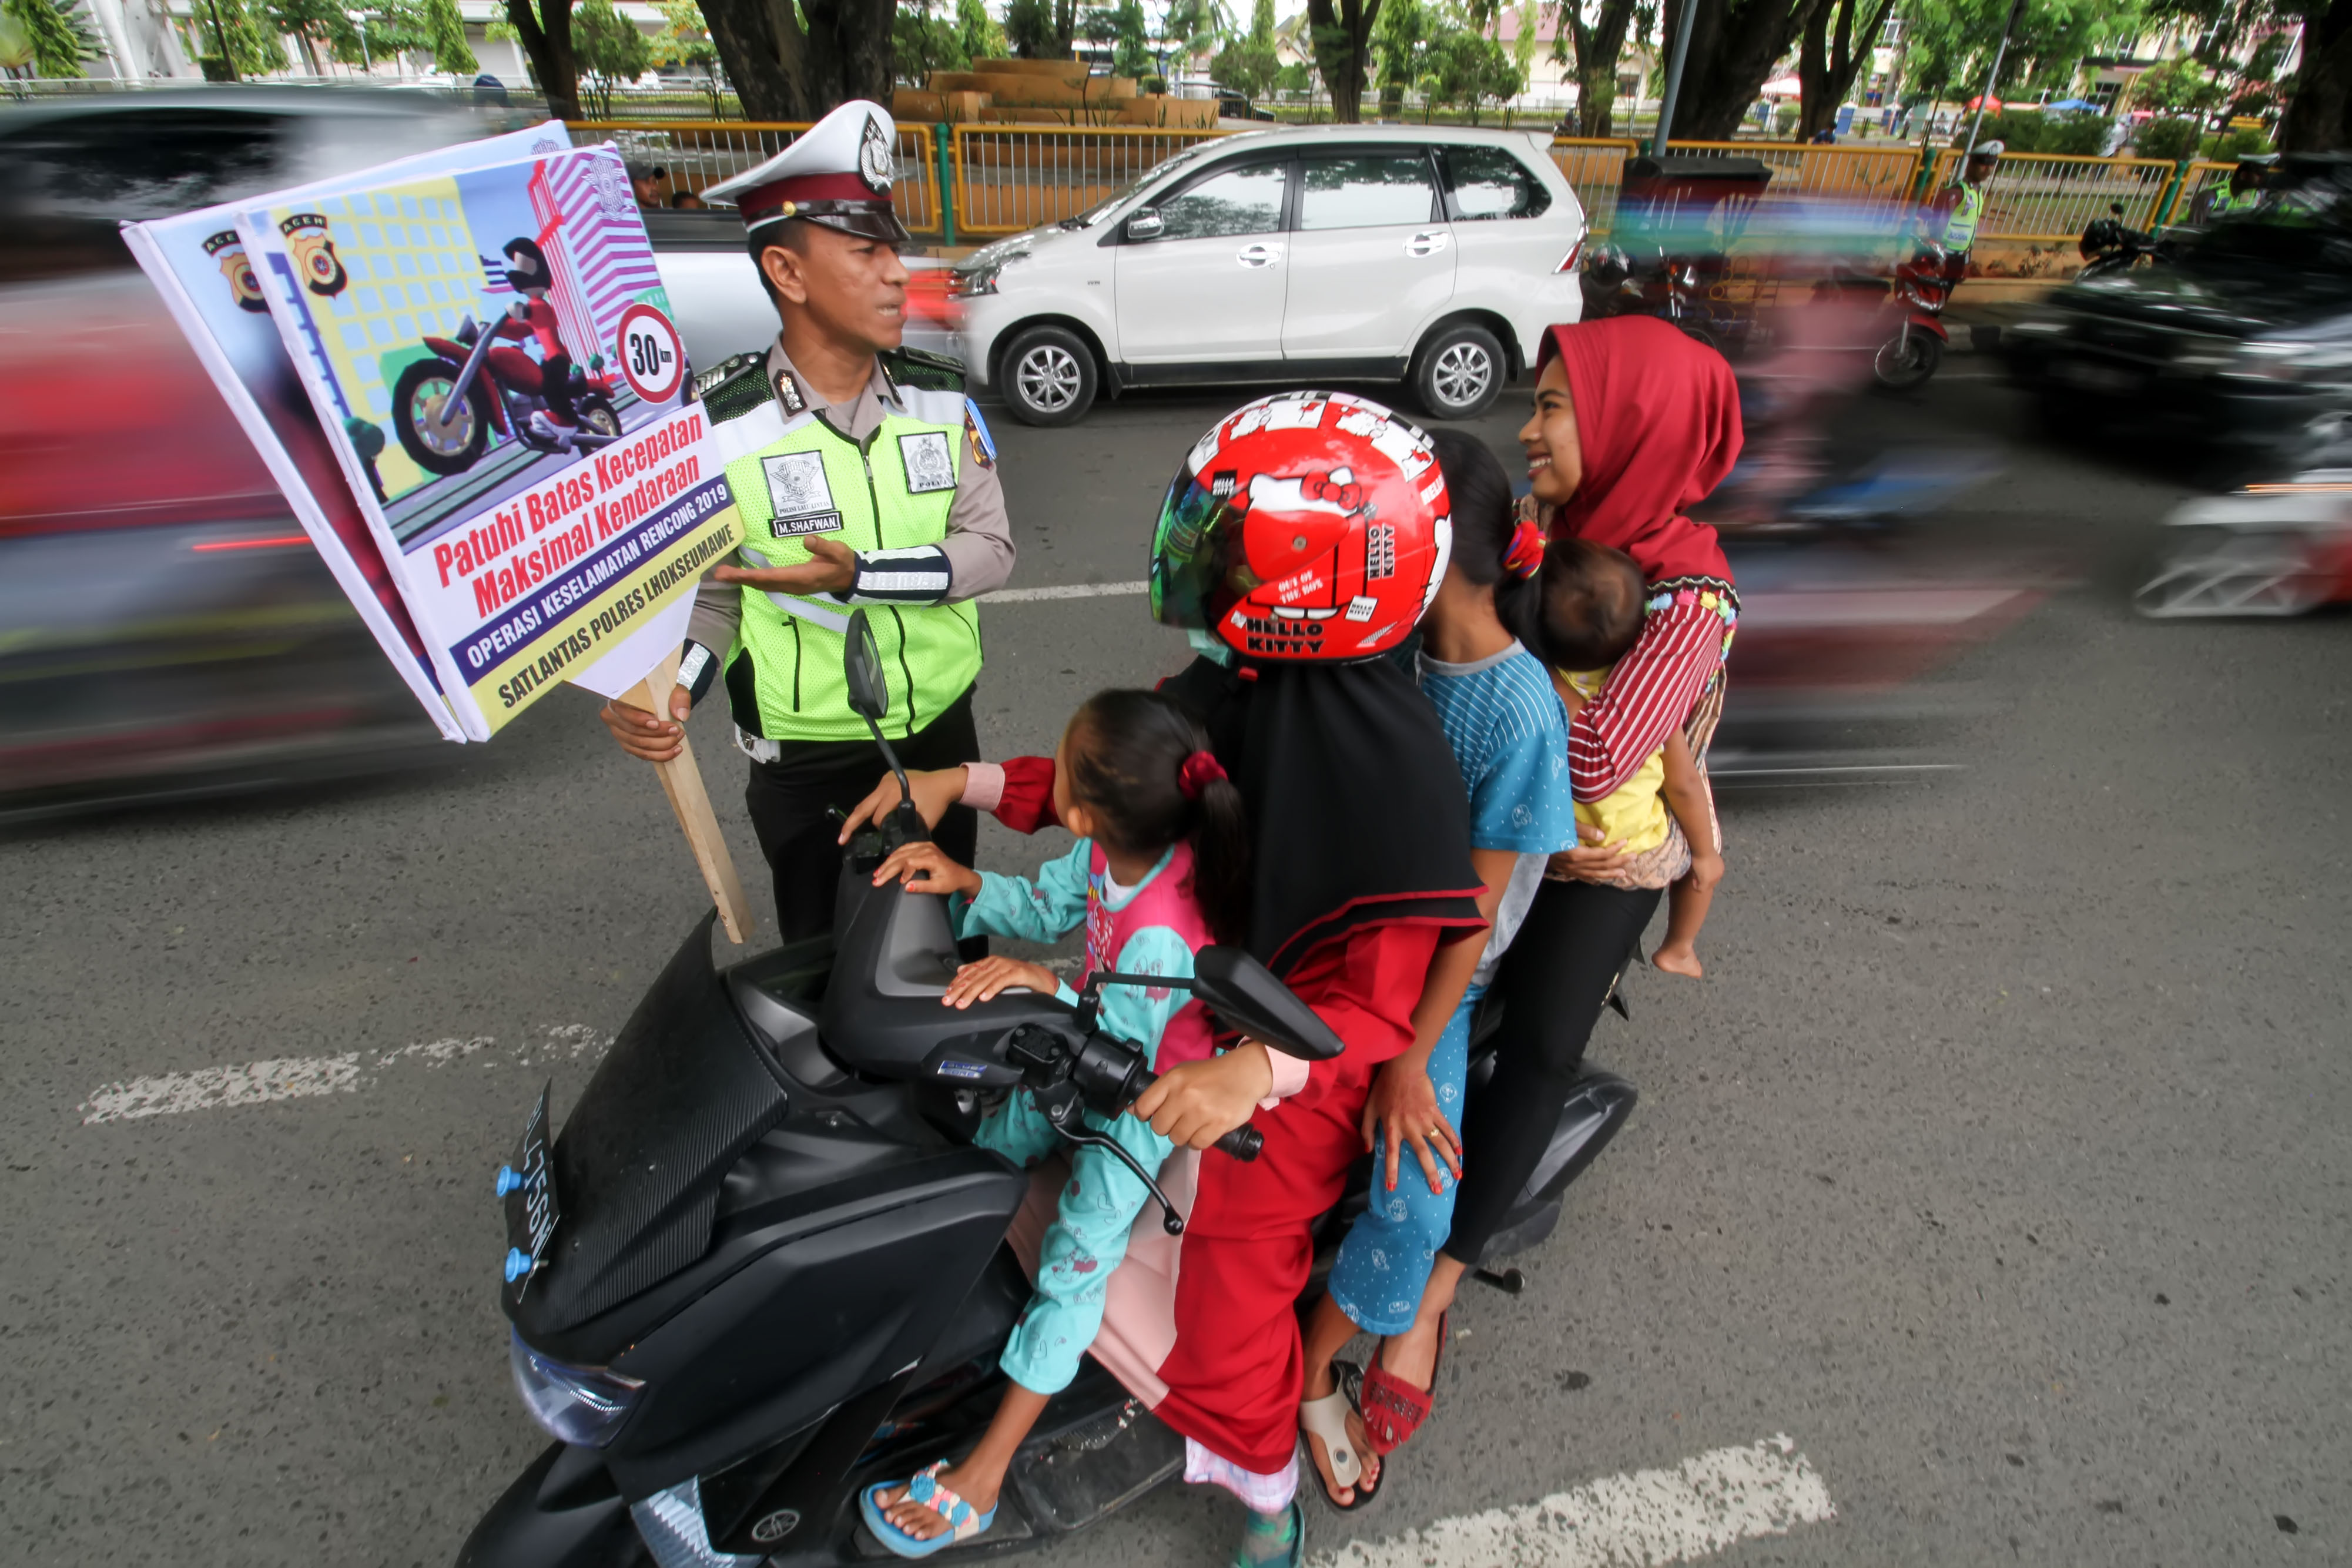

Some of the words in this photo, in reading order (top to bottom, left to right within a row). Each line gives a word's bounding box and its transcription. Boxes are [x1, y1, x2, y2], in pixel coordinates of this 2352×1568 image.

[283, 216, 324, 233] ACEH
[629, 333, 659, 376] 30
[659, 348, 672, 363] km
[433, 503, 525, 588] Patuhi
[525, 471, 594, 534] Batas
[594, 413, 702, 494] Kecepatan
[919, 480, 947, 488] POLII
[778, 516, 836, 534] M.SHAFWAN
[779, 505, 796, 514] POLISI
[472, 513, 595, 619] Maksimal
[594, 455, 700, 541] Kendaraan
[1368, 525, 1381, 581] HELLO
[1382, 522, 1395, 578] KITTY
[467, 608, 541, 668] OPERASI
[540, 548, 639, 619] KESELAMATAN
[639, 501, 696, 552] RENCONG
[695, 483, 728, 512] 2019
[498, 626, 592, 709] SATLANTAS
[589, 588, 645, 642] POLRES
[643, 523, 735, 602] LHOKSEUMAWE
[1247, 617, 1324, 636] HELLO
[1247, 636, 1325, 654] KITTY
